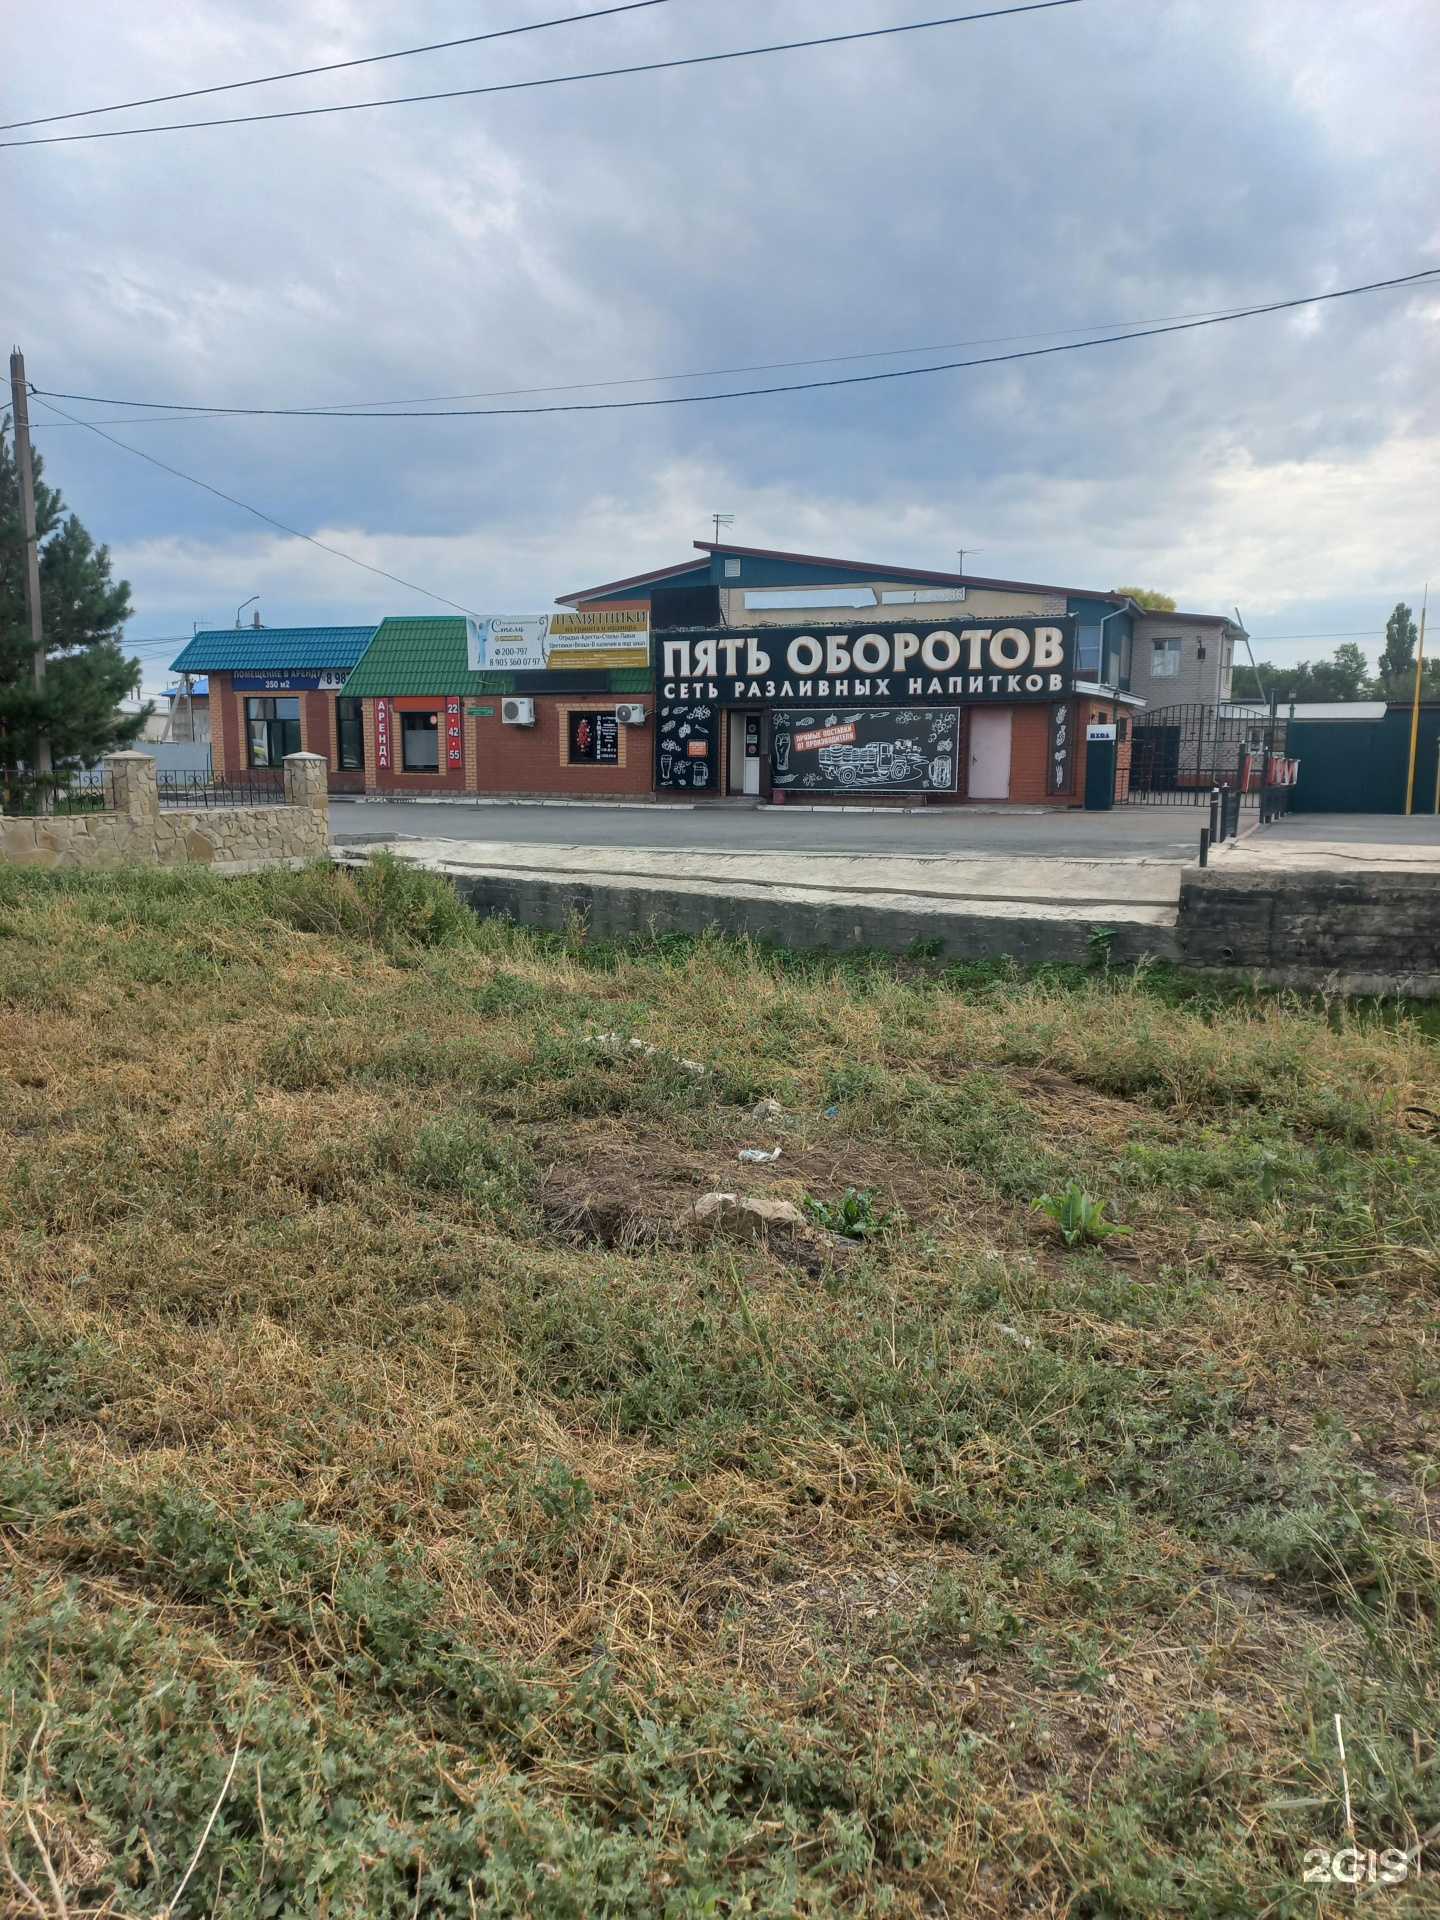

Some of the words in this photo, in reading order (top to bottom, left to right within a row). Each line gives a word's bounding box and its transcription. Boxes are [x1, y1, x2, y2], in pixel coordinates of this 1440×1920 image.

[663, 638, 771, 677] ПЯТЬ
[786, 626, 1065, 675] ОБОРОТОВ
[233, 670, 281, 680] ПОМЕЩЕНИЕ
[290, 669, 321, 679] АРЕНДУ
[326, 672, 333, 685] 8
[664, 681, 718, 699] СЕТЬ
[734, 679, 891, 698] РАЗЛИВНЫХ
[908, 674, 1063, 695] НАПИТКОВ
[447, 704, 458, 714] 22
[377, 701, 387, 767] АРЕНДА
[448, 728, 459, 737] 42
[449, 750, 460, 759] 55
